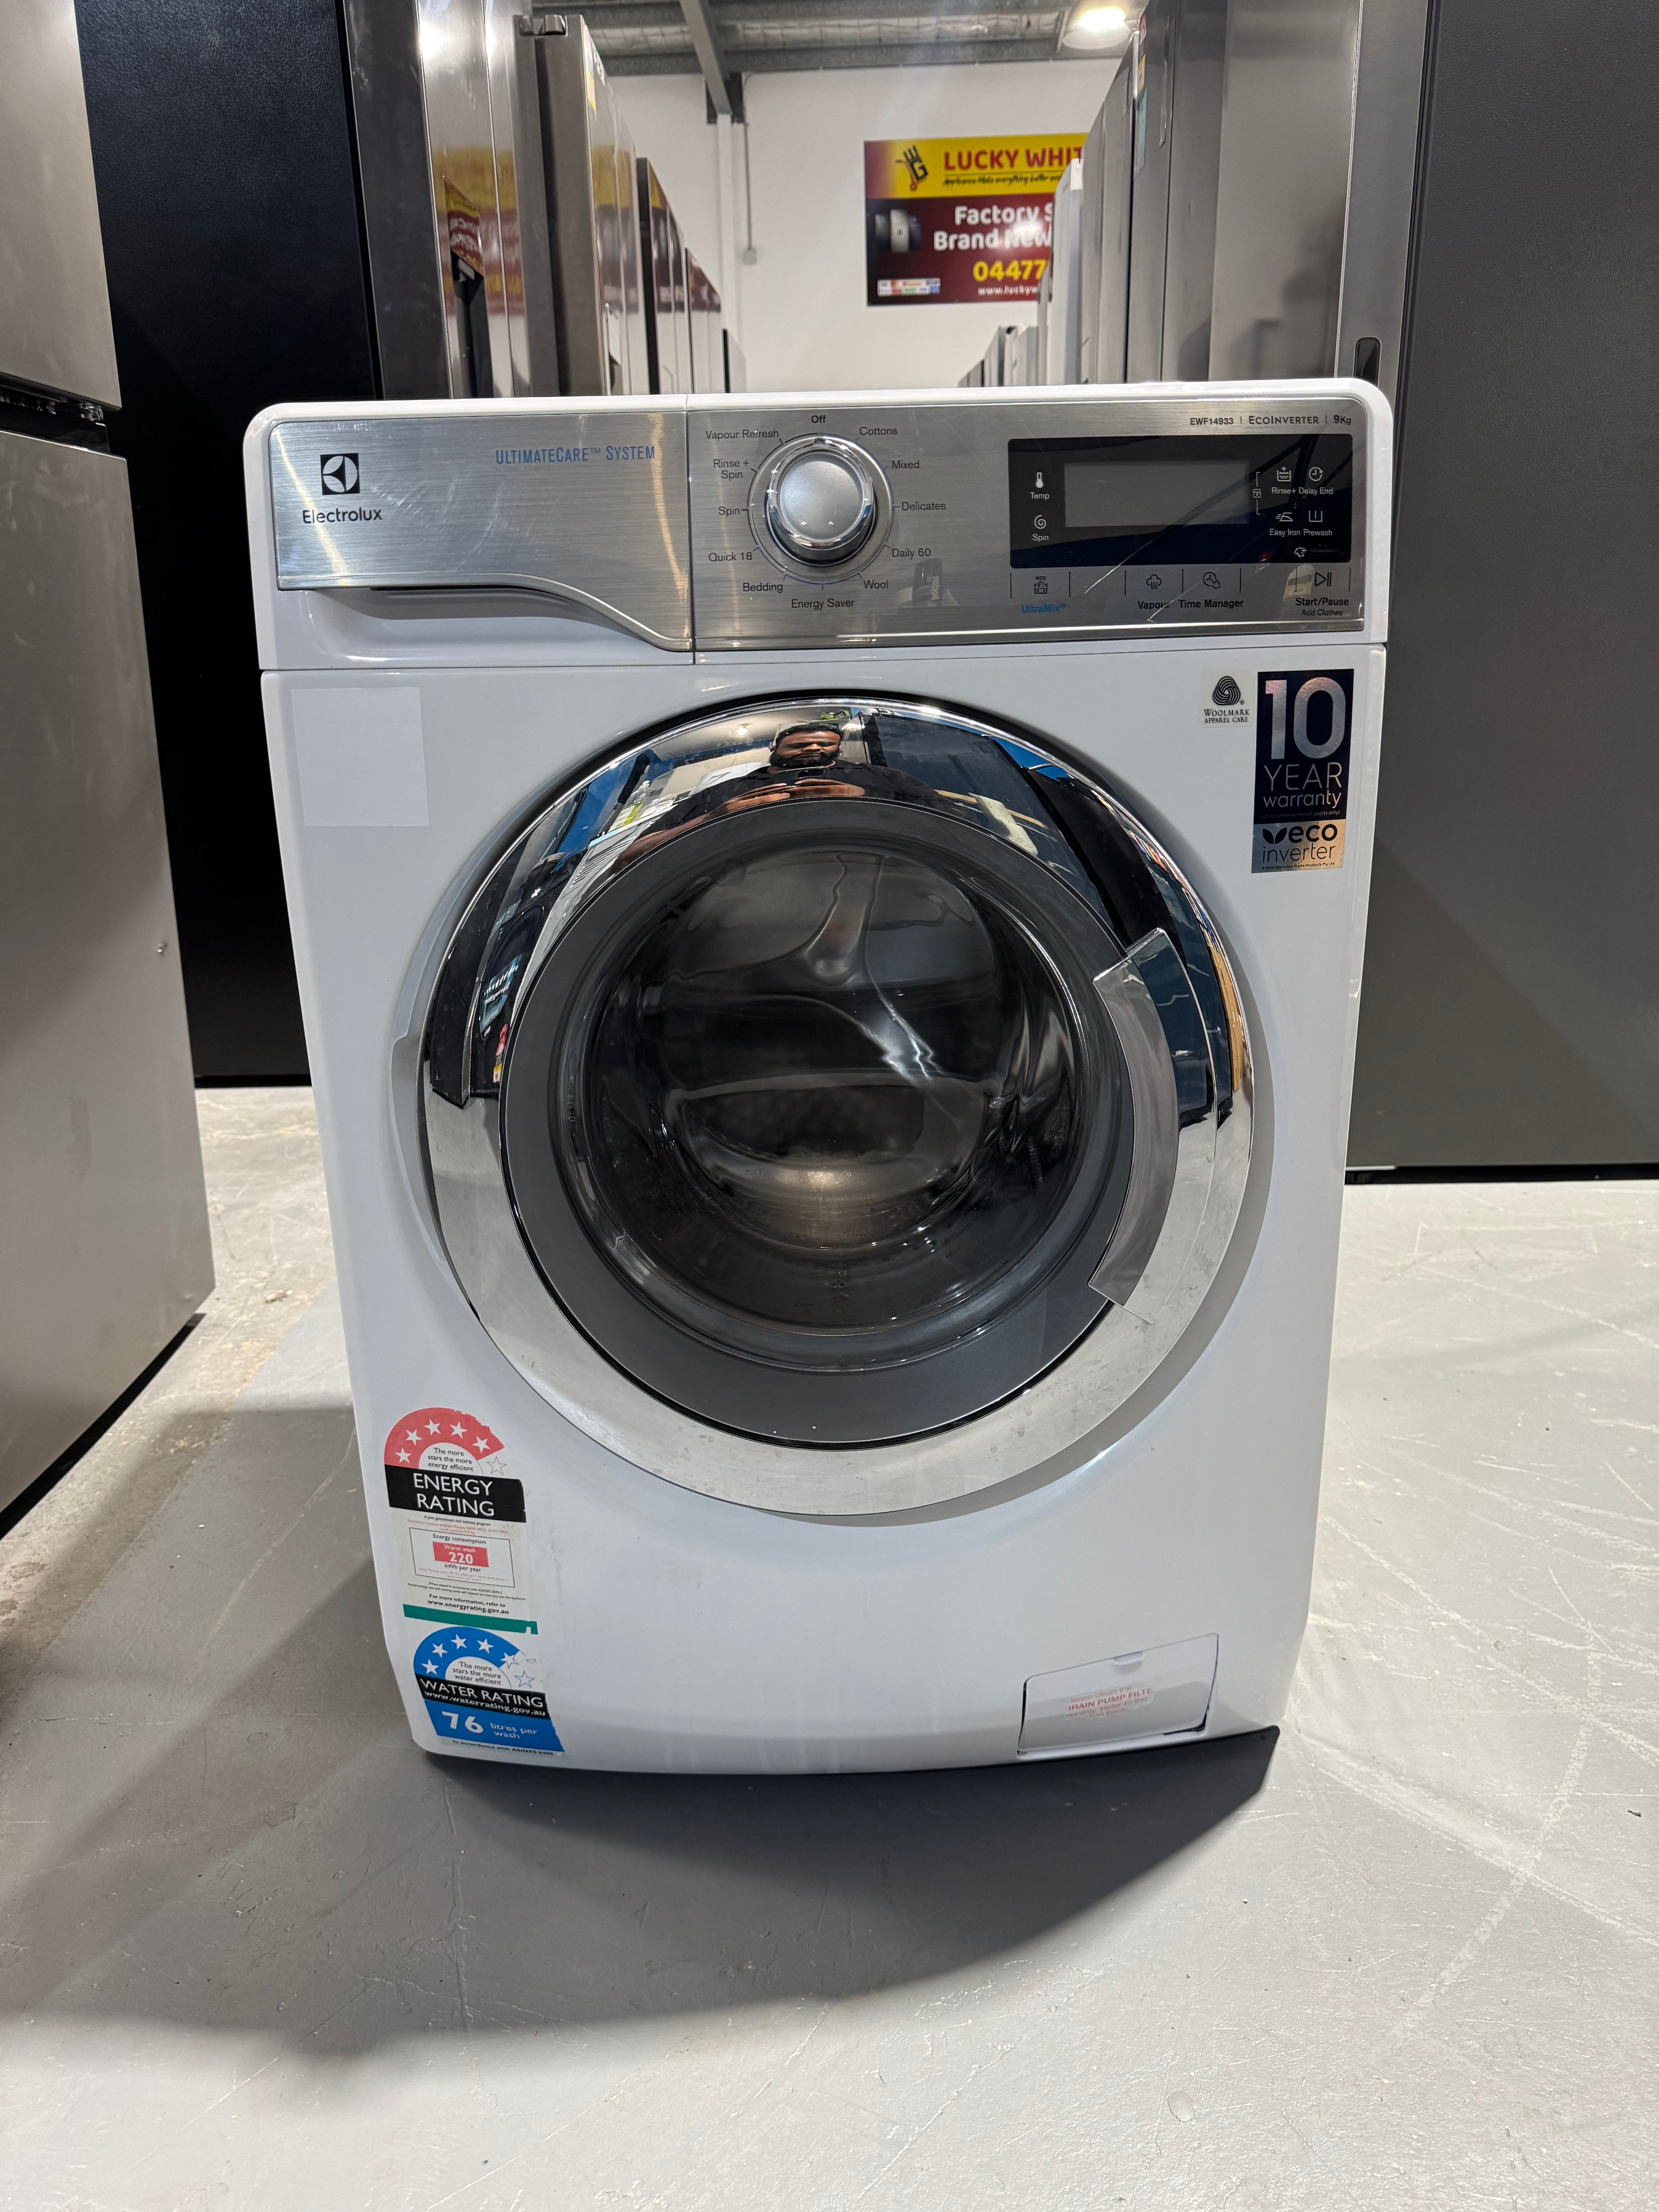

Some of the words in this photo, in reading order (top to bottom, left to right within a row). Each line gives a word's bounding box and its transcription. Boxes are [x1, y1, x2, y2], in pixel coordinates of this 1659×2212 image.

[944, 149, 1018, 170] LUCKY
[955, 204, 1040, 226] Factory
[934, 228, 999, 251] Brand
[1004, 228, 1051, 249] New
[972, 259, 1047, 282] 04477
[812, 415, 826, 424] Off
[1334, 415, 1352, 425] 9Kg
[706, 431, 740, 441] Vapour
[742, 429, 779, 438] Refresh
[859, 426, 898, 436] Cottons
[606, 445, 655, 460] SYSTEM
[713, 459, 740, 468] Rinse
[892, 459, 920, 469] Mixed
[721, 470, 743, 481] Spin
[1030, 492, 1050, 501] Temp
[1272, 487, 1297, 495] Rinse+
[1299, 487, 1318, 496] Delay
[718, 506, 740, 517] Spin
[902, 501, 946, 511] Delicates
[302, 507, 383, 524] Electrolux
[1032, 533, 1049, 543] Spin
[1270, 529, 1286, 538] Easy
[709, 552, 738, 562] Quick
[741, 552, 752, 561] 18
[892, 548, 915, 560] Daily
[918, 548, 931, 557] 60
[743, 582, 783, 594] Bedding
[864, 580, 888, 590] Wool
[791, 599, 824, 610] Energy
[827, 598, 855, 608] Saver
[1138, 600, 1170, 611] Vapour
[1178, 599, 1201, 608] Time
[1204, 599, 1244, 609] Manager
[1295, 597, 1349, 606] Start/Pause
[1204, 708, 1250, 717] WOOLMARK
[1265, 676, 1346, 760] 10
[1264, 762, 1342, 792] YEAR
[1262, 788, 1342, 809] warranty
[1288, 823, 1338, 844] eco
[1262, 842, 1336, 864] inverter
[413, 1472, 493, 1496] ENERGY
[417, 1493, 495, 1516] RATING
[433, 1533, 450, 1541] Energy
[452, 1537, 486, 1545] consumption
[448, 1551, 474, 1565] 220
[428, 1599, 509, 1614] www.energyrating.gov.au
[454, 1597, 485, 1606] information,
[475, 1677, 501, 1685] efficient
[420, 1678, 478, 1699] WATER
[481, 1690, 544, 1707] RATING
[1097, 1694, 1126, 1705] PUMP
[1128, 1687, 1154, 1698] FILTE
[424, 1690, 546, 1716] www.waterrating.gov.au
[1071, 1695, 1093, 1703] lease
[441, 1711, 484, 1734] 76
[490, 1722, 517, 1732] litres
[494, 1731, 520, 1739] wash
